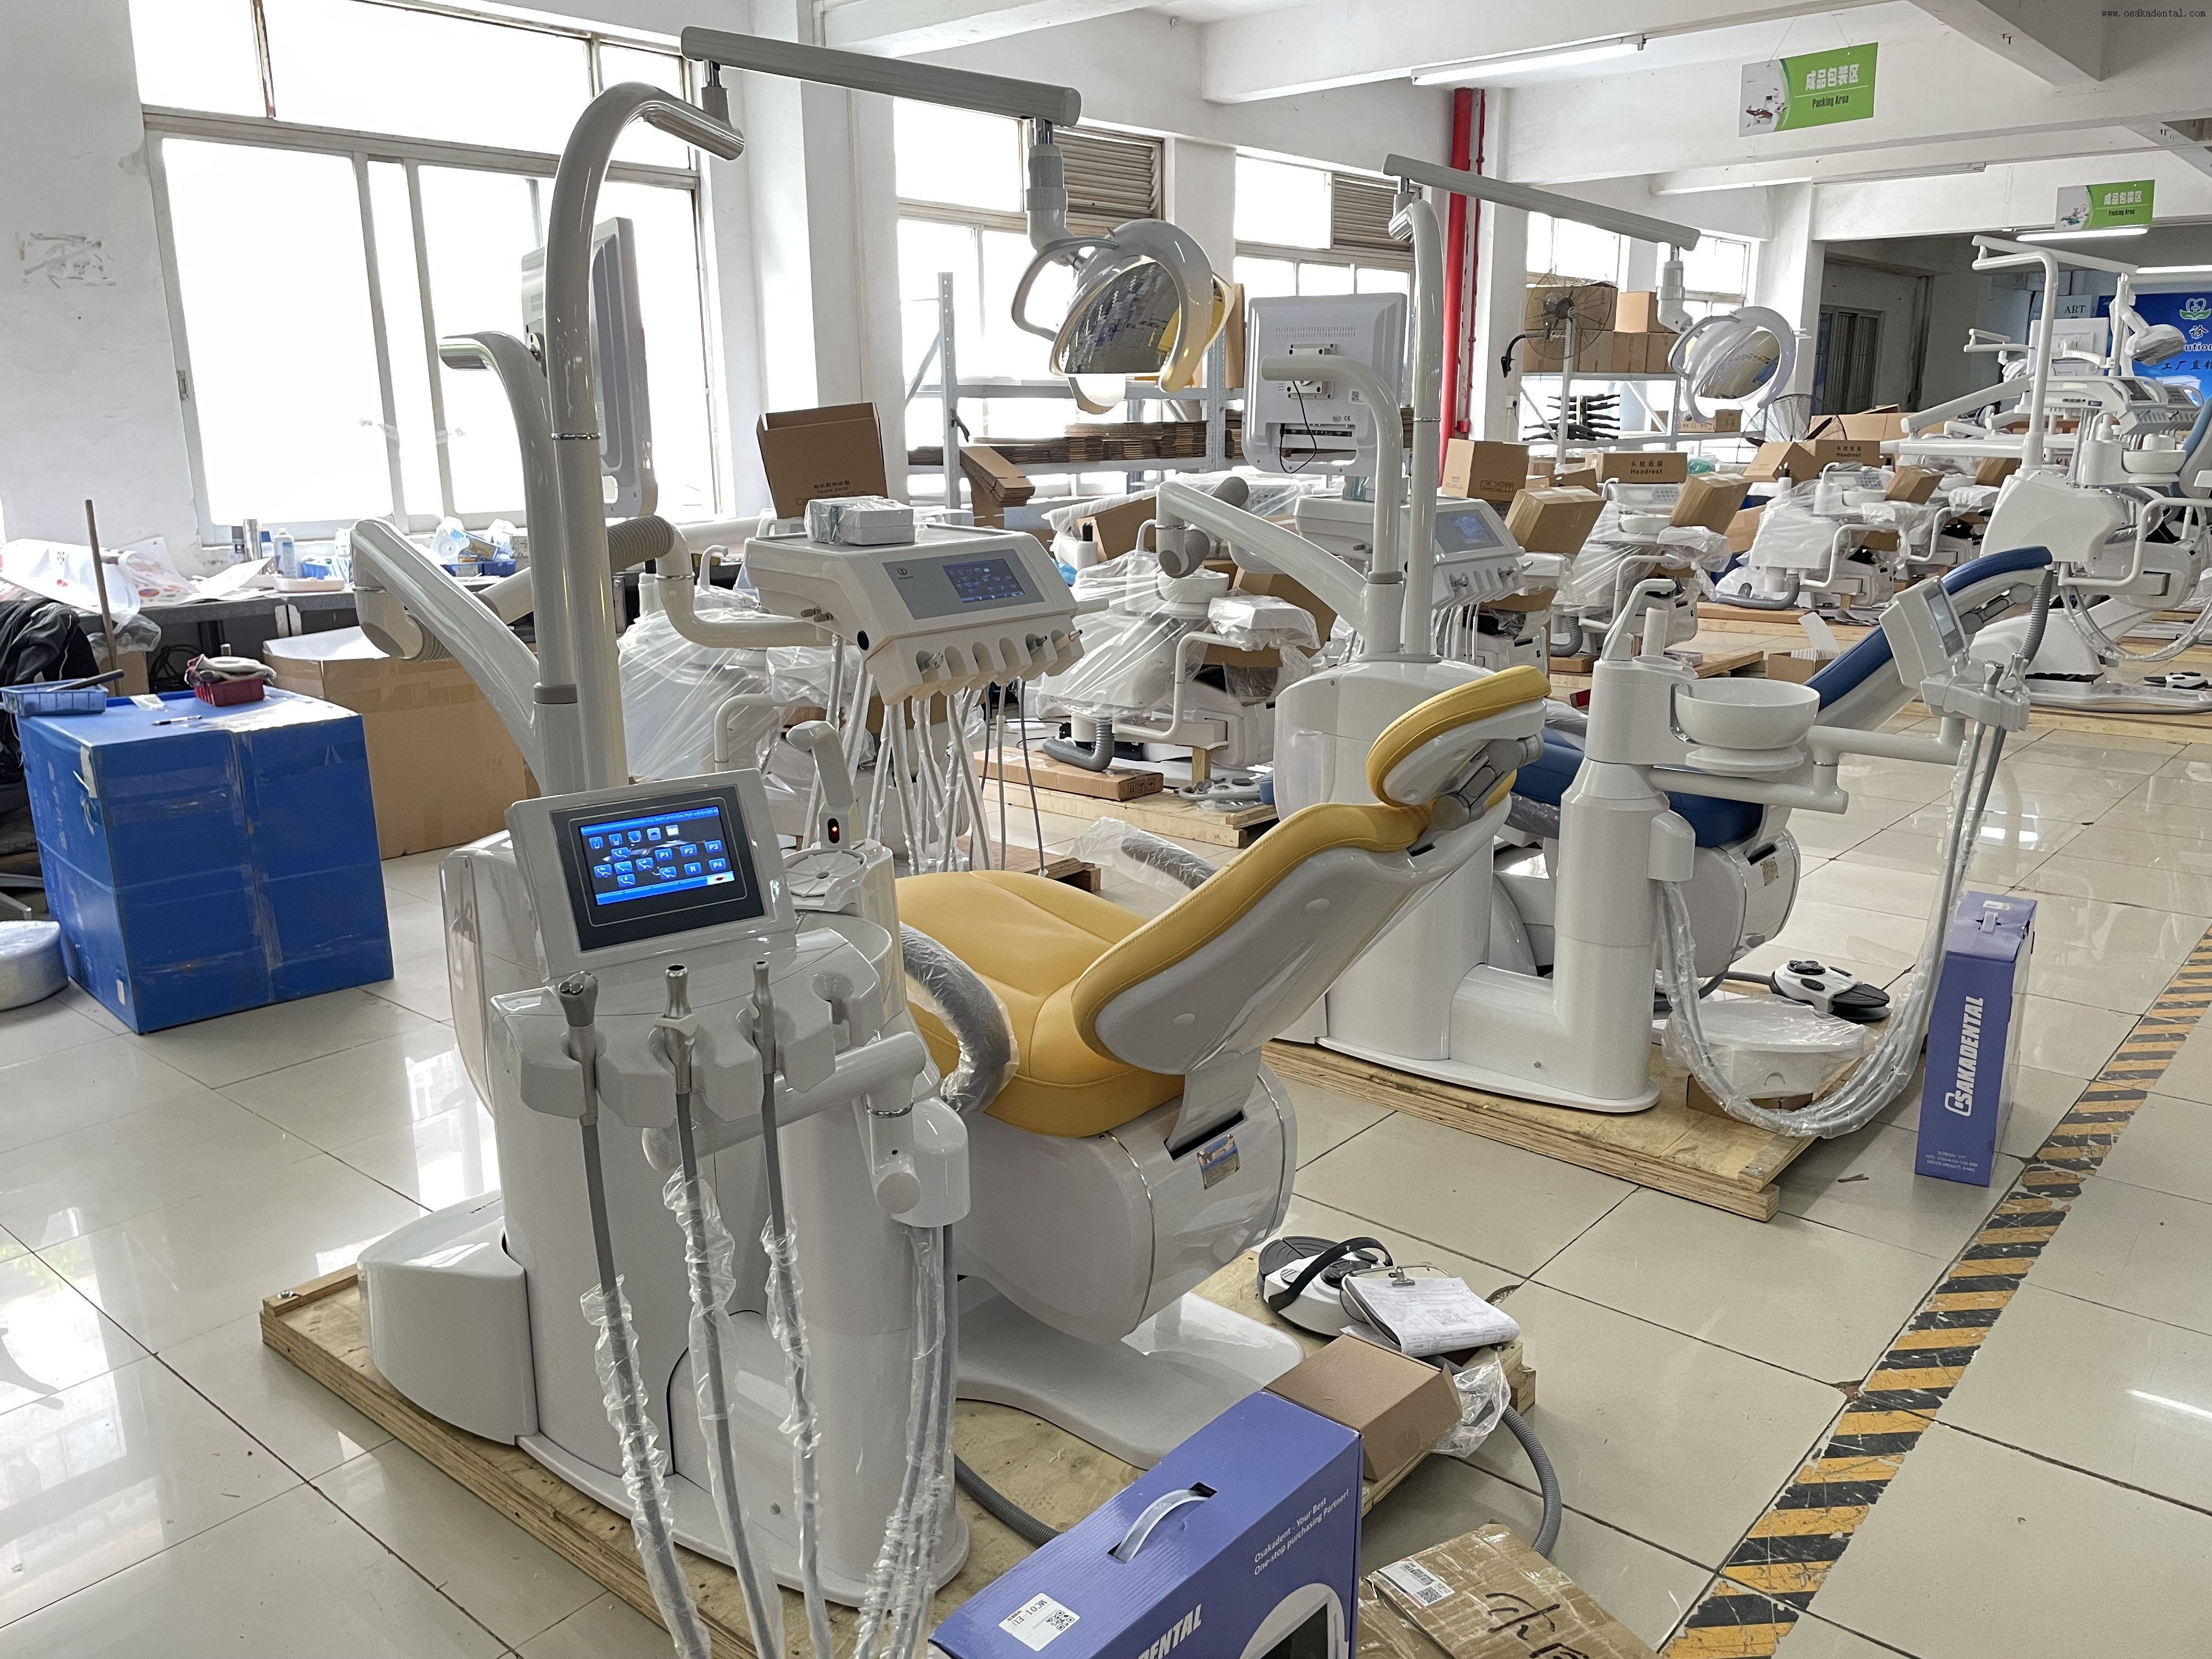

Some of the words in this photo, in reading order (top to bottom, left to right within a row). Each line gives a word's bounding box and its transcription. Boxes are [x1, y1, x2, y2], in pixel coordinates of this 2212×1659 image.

[1805, 63, 1859, 91] 成品包装区
[1812, 96, 1835, 109] Packing
[1835, 95, 1849, 105] Area
[2064, 304, 2086, 314] ART
[1254, 1545, 1286, 1575] One-stop
[1287, 1514, 1323, 1550] purchasing
[1323, 1488, 1349, 1517] Partner!
[1255, 1528, 1291, 1562] Osakadent
[1296, 1511, 1312, 1527] Your
[1312, 1497, 1327, 1514] Best
